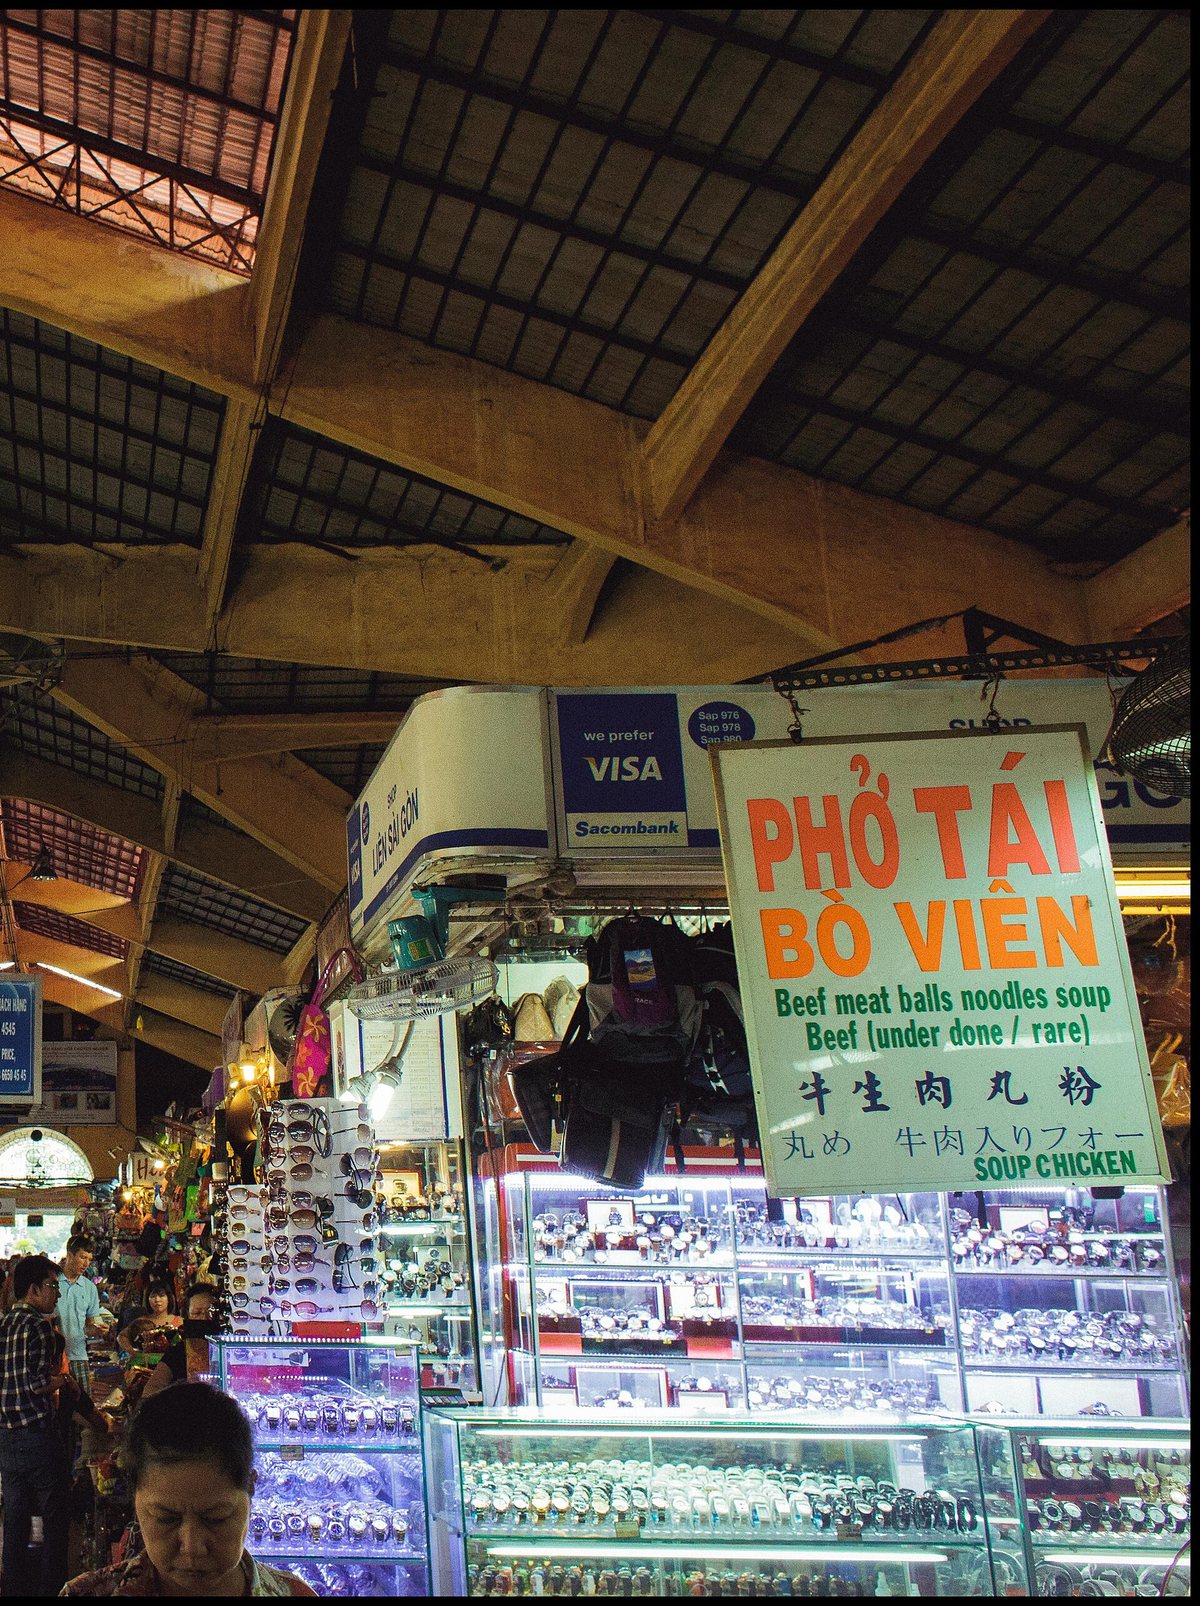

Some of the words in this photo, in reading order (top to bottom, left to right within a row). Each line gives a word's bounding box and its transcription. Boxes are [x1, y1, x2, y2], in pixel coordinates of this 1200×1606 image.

[698, 711, 719, 721] Sap
[720, 711, 740, 720] 976
[700, 723, 720, 733] Sap
[722, 722, 741, 732] 978
[583, 732, 605, 741] we
[608, 730, 655, 744] prefer
[582, 756, 663, 782] VISA
[388, 811, 399, 856] SÀI
[400, 787, 419, 838] GÒN
[575, 820, 680, 838] Sacombank
[746, 754, 901, 892] PHỞ
[913, 751, 1082, 880] TÁI
[758, 889, 872, 980] BÒ
[894, 879, 1100, 972] VIÊN
[775, 987, 828, 1017] Beef
[835, 985, 891, 1015] meat
[898, 981, 952, 1013] balls
[961, 980, 1048, 1010] noodles
[1056, 985, 1112, 1013] soup
[1, 1021, 16, 1036] 4545
[805, 1021, 859, 1051] Beef
[867, 1017, 940, 1053] (under
[949, 1018, 1003, 1047] done
[1032, 1014, 1091, 1046] rare)
[974, 1153, 1031, 1182] SOUP
[1036, 1149, 1137, 1179] CHICKEN
